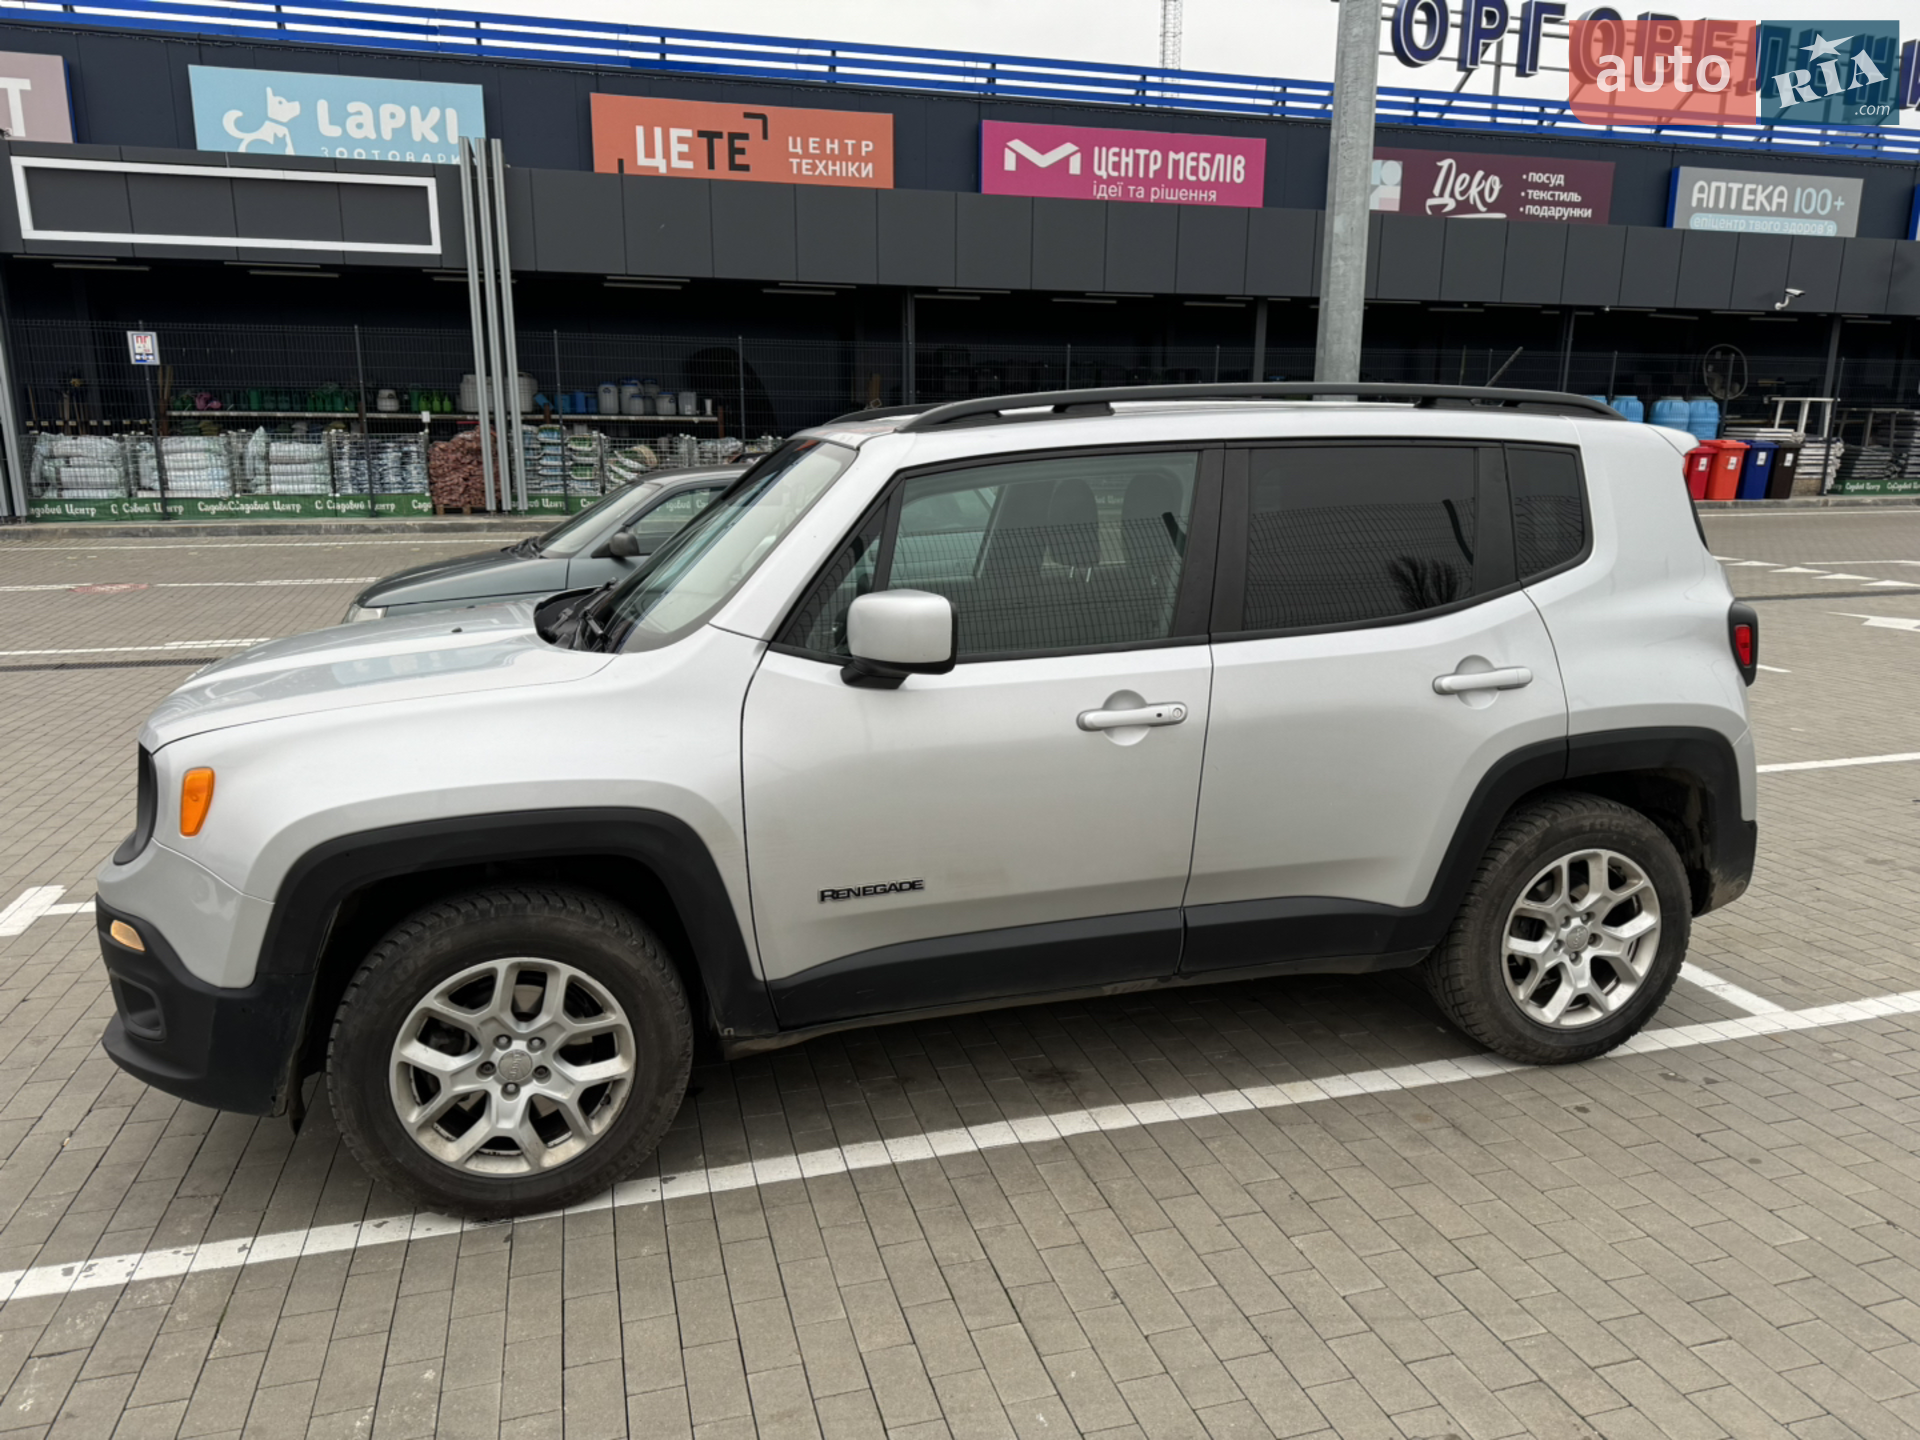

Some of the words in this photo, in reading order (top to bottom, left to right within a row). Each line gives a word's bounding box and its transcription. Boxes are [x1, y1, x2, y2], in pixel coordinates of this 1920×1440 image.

[635, 125, 751, 173] ЦЕТЕ
[788, 136, 874, 156] ЦЕНТР
[788, 158, 874, 178] ТЕХНІКИ
[1093, 146, 1162, 179] ЦЕНТР
[1167, 150, 1246, 183] МЕБЛІВ
[1425, 158, 1502, 215] Деко
[1528, 172, 1565, 186] посуд
[1093, 181, 1124, 199] ідеї
[1128, 185, 1145, 198] та
[1151, 184, 1217, 202] рішення
[1526, 189, 1582, 202] текстиль
[1690, 180, 1789, 213] АПТЕКА
[1793, 187, 1846, 216] 100+
[1525, 204, 1593, 220] подарунки
[1692, 217, 1747, 231] епіцентр
[1749, 221, 1781, 232] твого
[65, 504, 97, 517] Центр
[153, 502, 184, 515] Цнтр
[273, 501, 302, 513] Центр
[819, 880, 924, 902] RENEGADE
